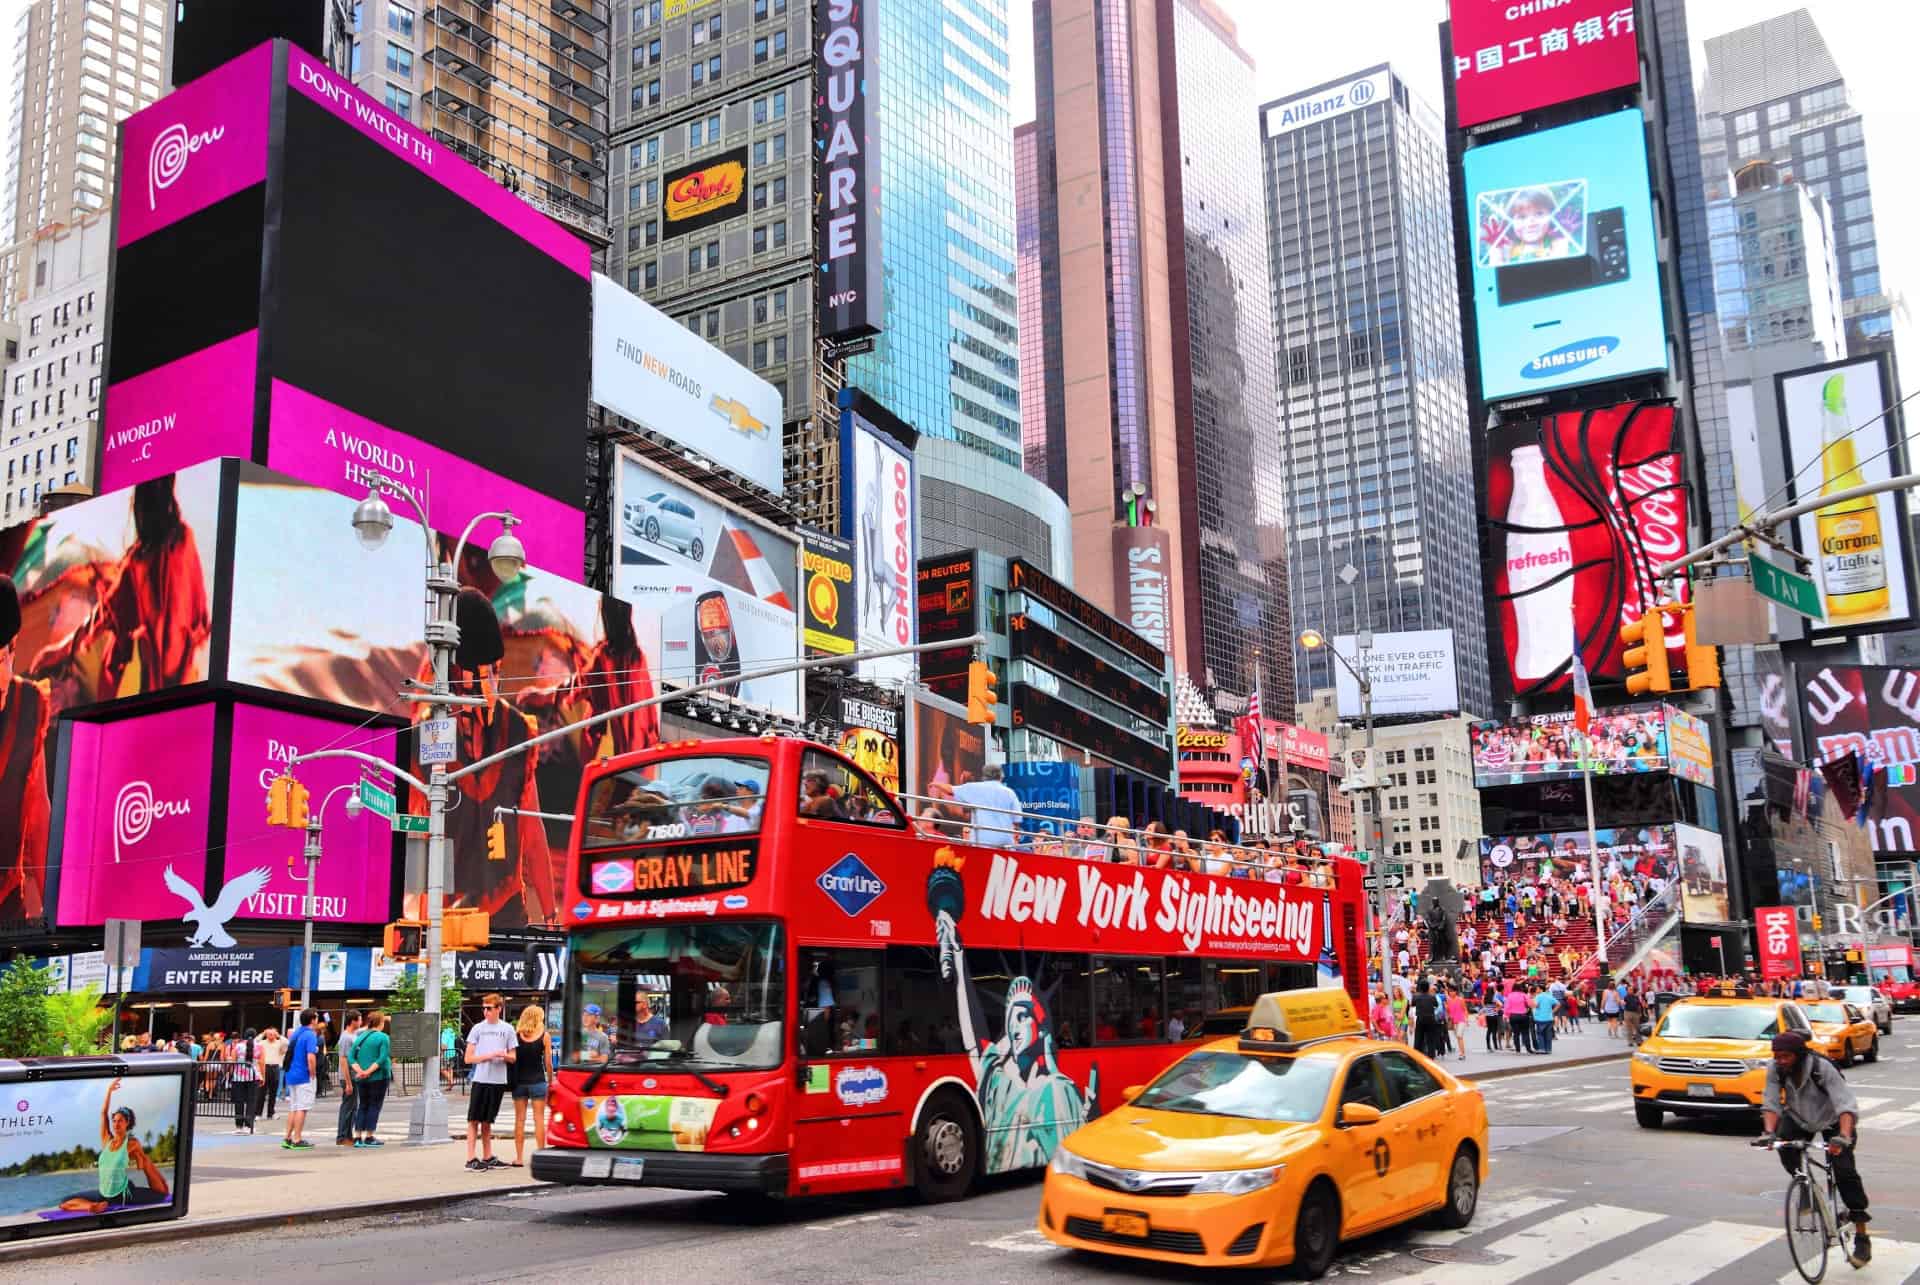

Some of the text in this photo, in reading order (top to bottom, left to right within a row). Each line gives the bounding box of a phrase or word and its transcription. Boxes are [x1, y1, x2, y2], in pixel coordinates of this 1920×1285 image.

[1281, 92, 1345, 126] Allianz
[355, 98, 409, 149] WATCH
[411, 137, 433, 165] TH
[829, 290, 856, 308] NYC
[616, 337, 702, 399] FIND NEW ROADS
[1532, 345, 1609, 370] SAMSUNG
[106, 434, 116, 452] A
[117, 418, 162, 448] WORLD
[324, 429, 338, 448] A
[341, 431, 404, 474] WORLD
[344, 462, 416, 504] HIDEN
[894, 461, 909, 646] CHICAGO
[1823, 534, 1879, 554] Corona
[801, 551, 852, 583] venue
[931, 561, 971, 578] REUTERS
[1508, 547, 1570, 571] refresh
[1837, 556, 1870, 571] Light
[1768, 570, 1777, 594] 7
[808, 572, 838, 630] Q
[1385, 664, 1395, 673] IN
[1398, 661, 1443, 672] TRAFFIC
[1388, 652, 1415, 661] EVER
[1418, 650, 1446, 659] GETS
[842, 699, 861, 718] THE
[862, 703, 896, 728] BIGGEST
[1022, 801, 1046, 811] Morgan
[113, 780, 190, 863] Peru
[403, 817, 412, 830] 7
[635, 850, 751, 890] GRAY LINE
[247, 892, 296, 915] VISIT
[648, 898, 719, 918] Sightseeing
[980, 854, 1314, 956] New York Sightseeing
[1765, 912, 1790, 955] tkts
[188, 953, 229, 961] AMERICAN
[475, 960, 499, 969] WE'RE
[165, 970, 274, 984] ENTER HERE
[475, 970, 495, 980] OPEN
